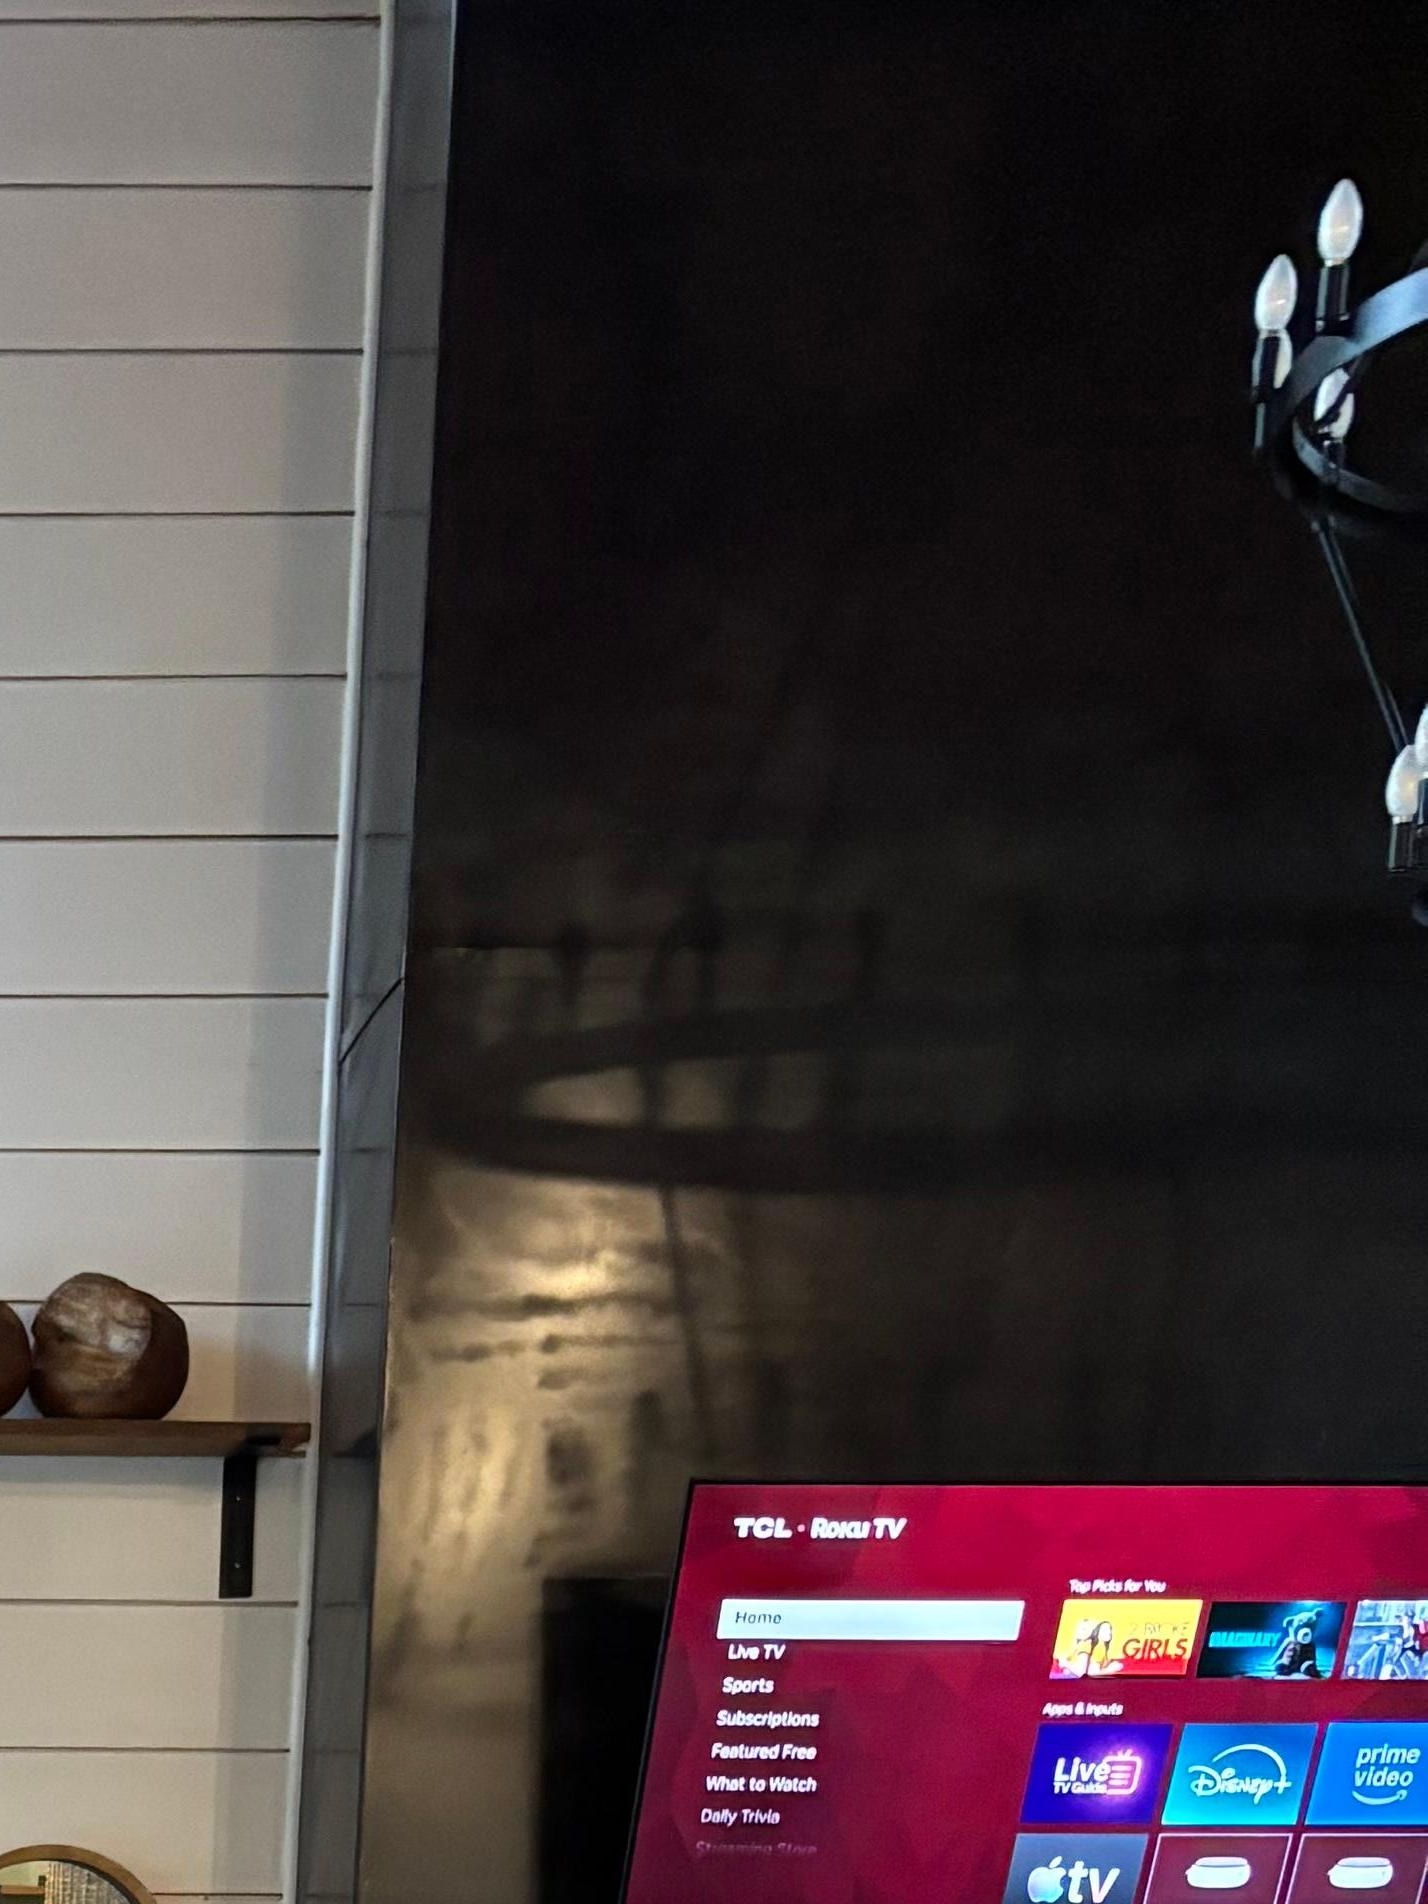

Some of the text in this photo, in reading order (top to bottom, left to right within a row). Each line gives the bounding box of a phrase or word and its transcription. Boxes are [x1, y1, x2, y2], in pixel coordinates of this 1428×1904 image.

[733, 1517, 907, 1539] TCL Roku TV
[1069, 1579, 1167, 1594] Top Picks for You
[735, 1611, 782, 1625] Home
[728, 1644, 786, 1660] Live TV
[1122, 1638, 1188, 1660] GIRLS
[722, 1676, 775, 1695] Sports
[716, 1710, 820, 1729] Subscriptions
[1042, 1703, 1074, 1718] Apps
[1086, 1702, 1124, 1717] Inputs
[711, 1743, 817, 1760] Featured Free
[1355, 1743, 1421, 1768] prime
[1054, 1756, 1111, 1782] Live
[1354, 1766, 1414, 1787] video
[706, 1775, 817, 1792] What to Watch
[701, 1808, 781, 1828] Daily Trivia
